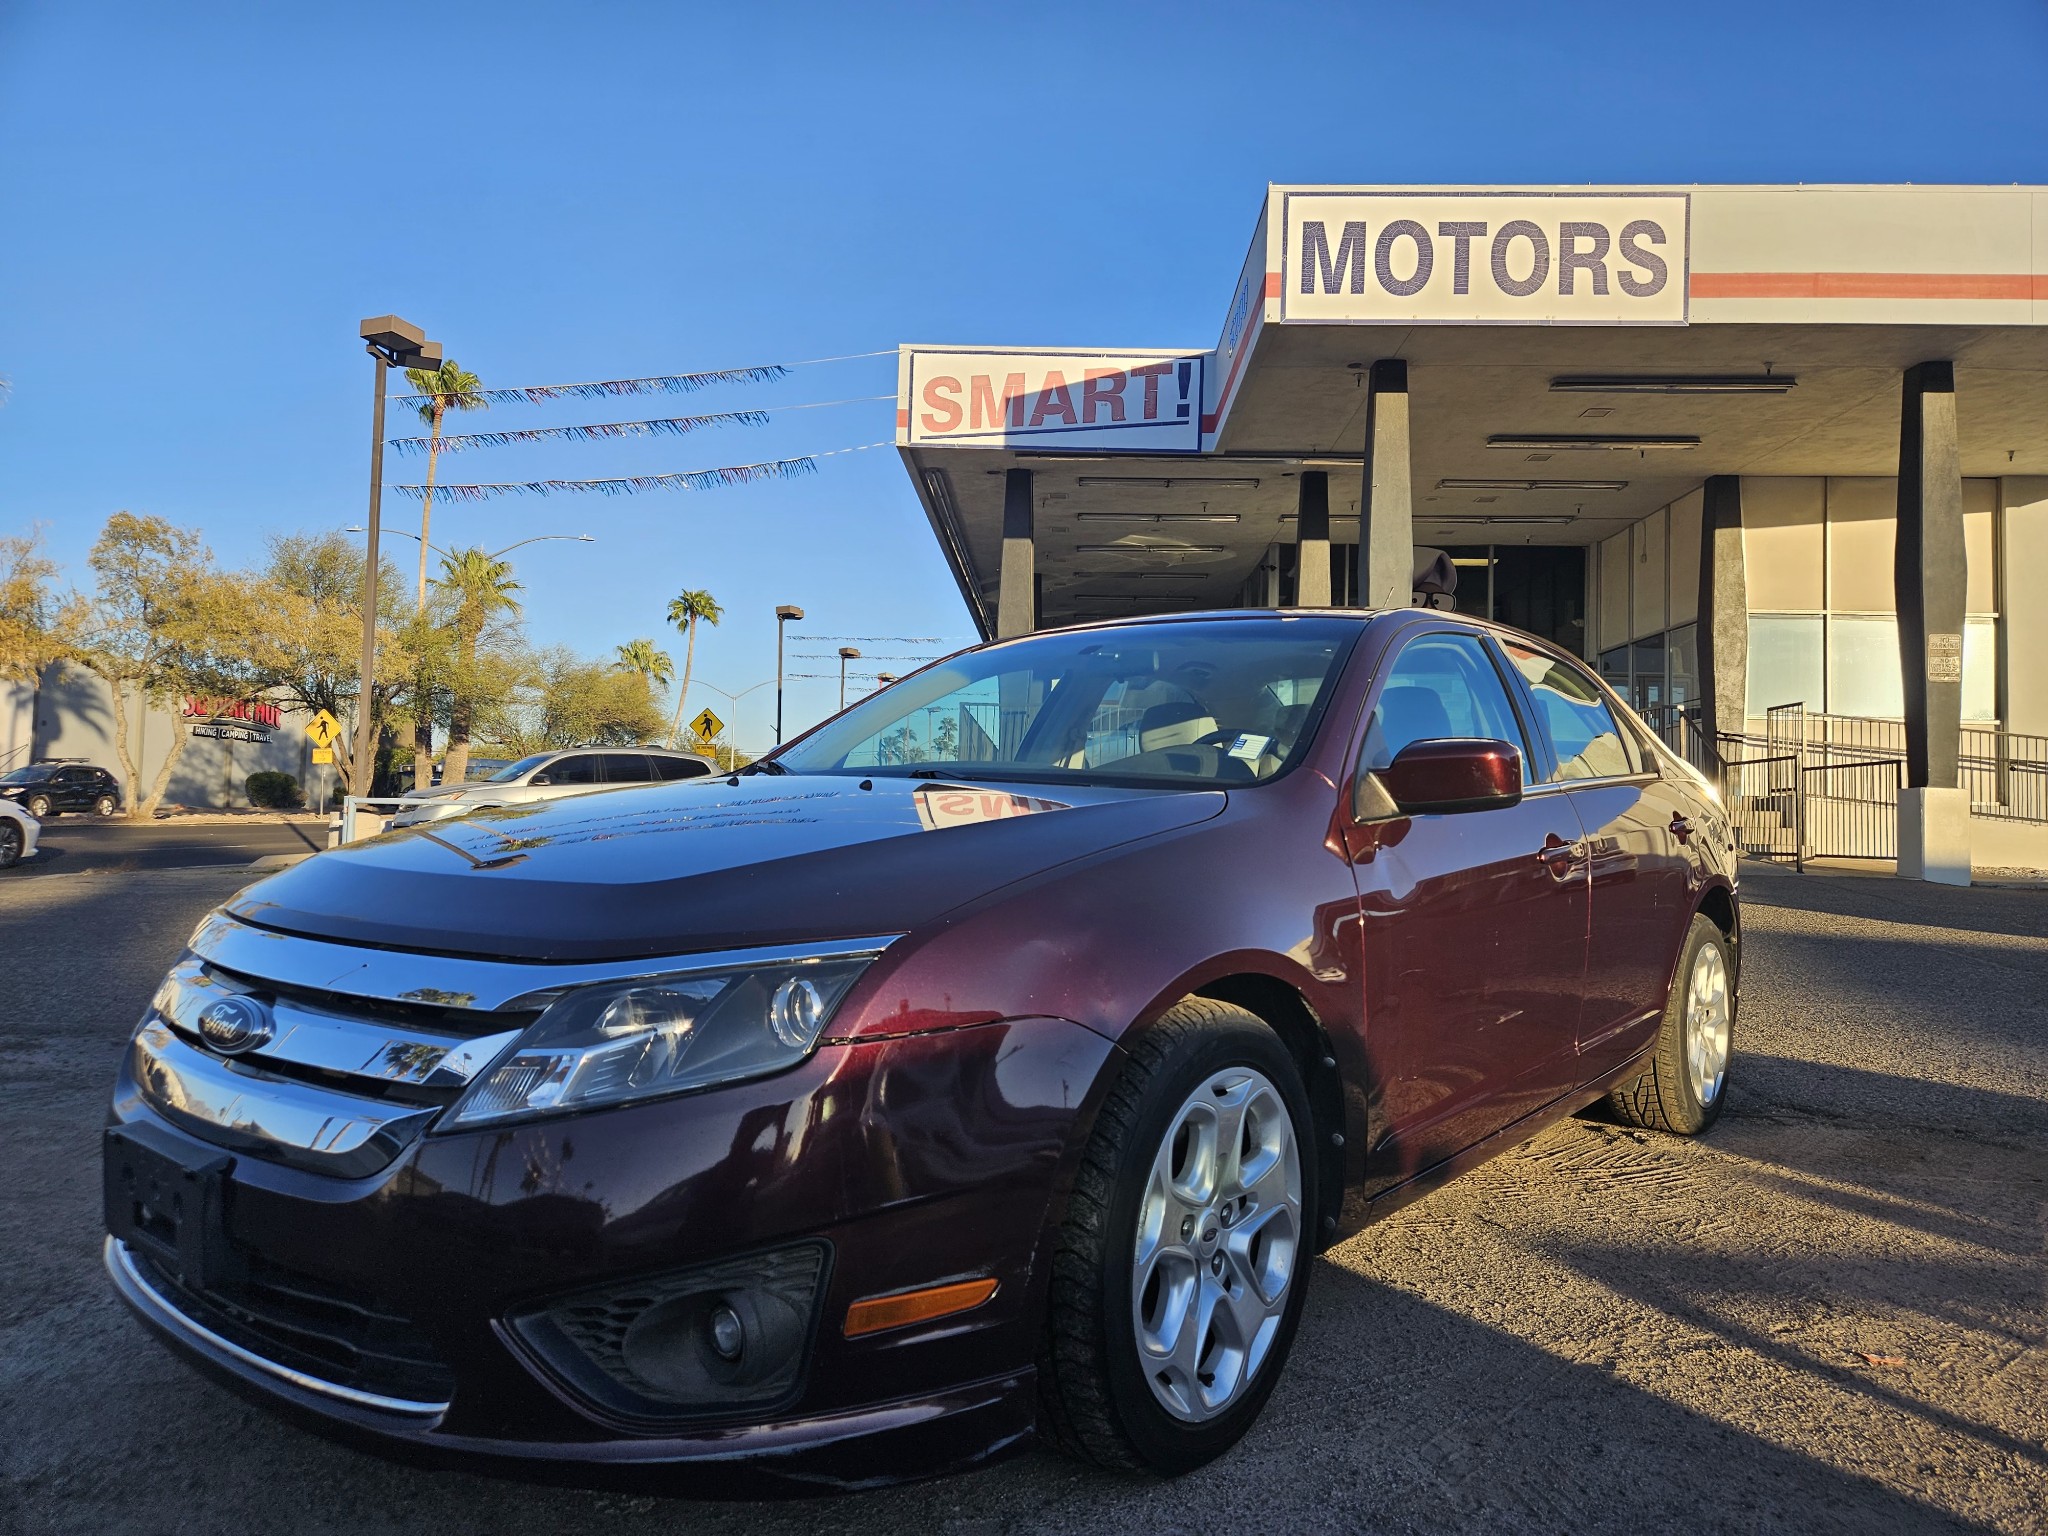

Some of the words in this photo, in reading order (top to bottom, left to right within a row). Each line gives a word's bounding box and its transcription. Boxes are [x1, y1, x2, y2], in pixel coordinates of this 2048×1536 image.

[1300, 219, 1669, 297] MOTORS
[920, 361, 1192, 433] SMART!
[195, 726, 218, 737] HIKING
[221, 729, 249, 740] CAMPING
[253, 733, 273, 743] TRAVEL
[204, 1004, 242, 1039] Ford
